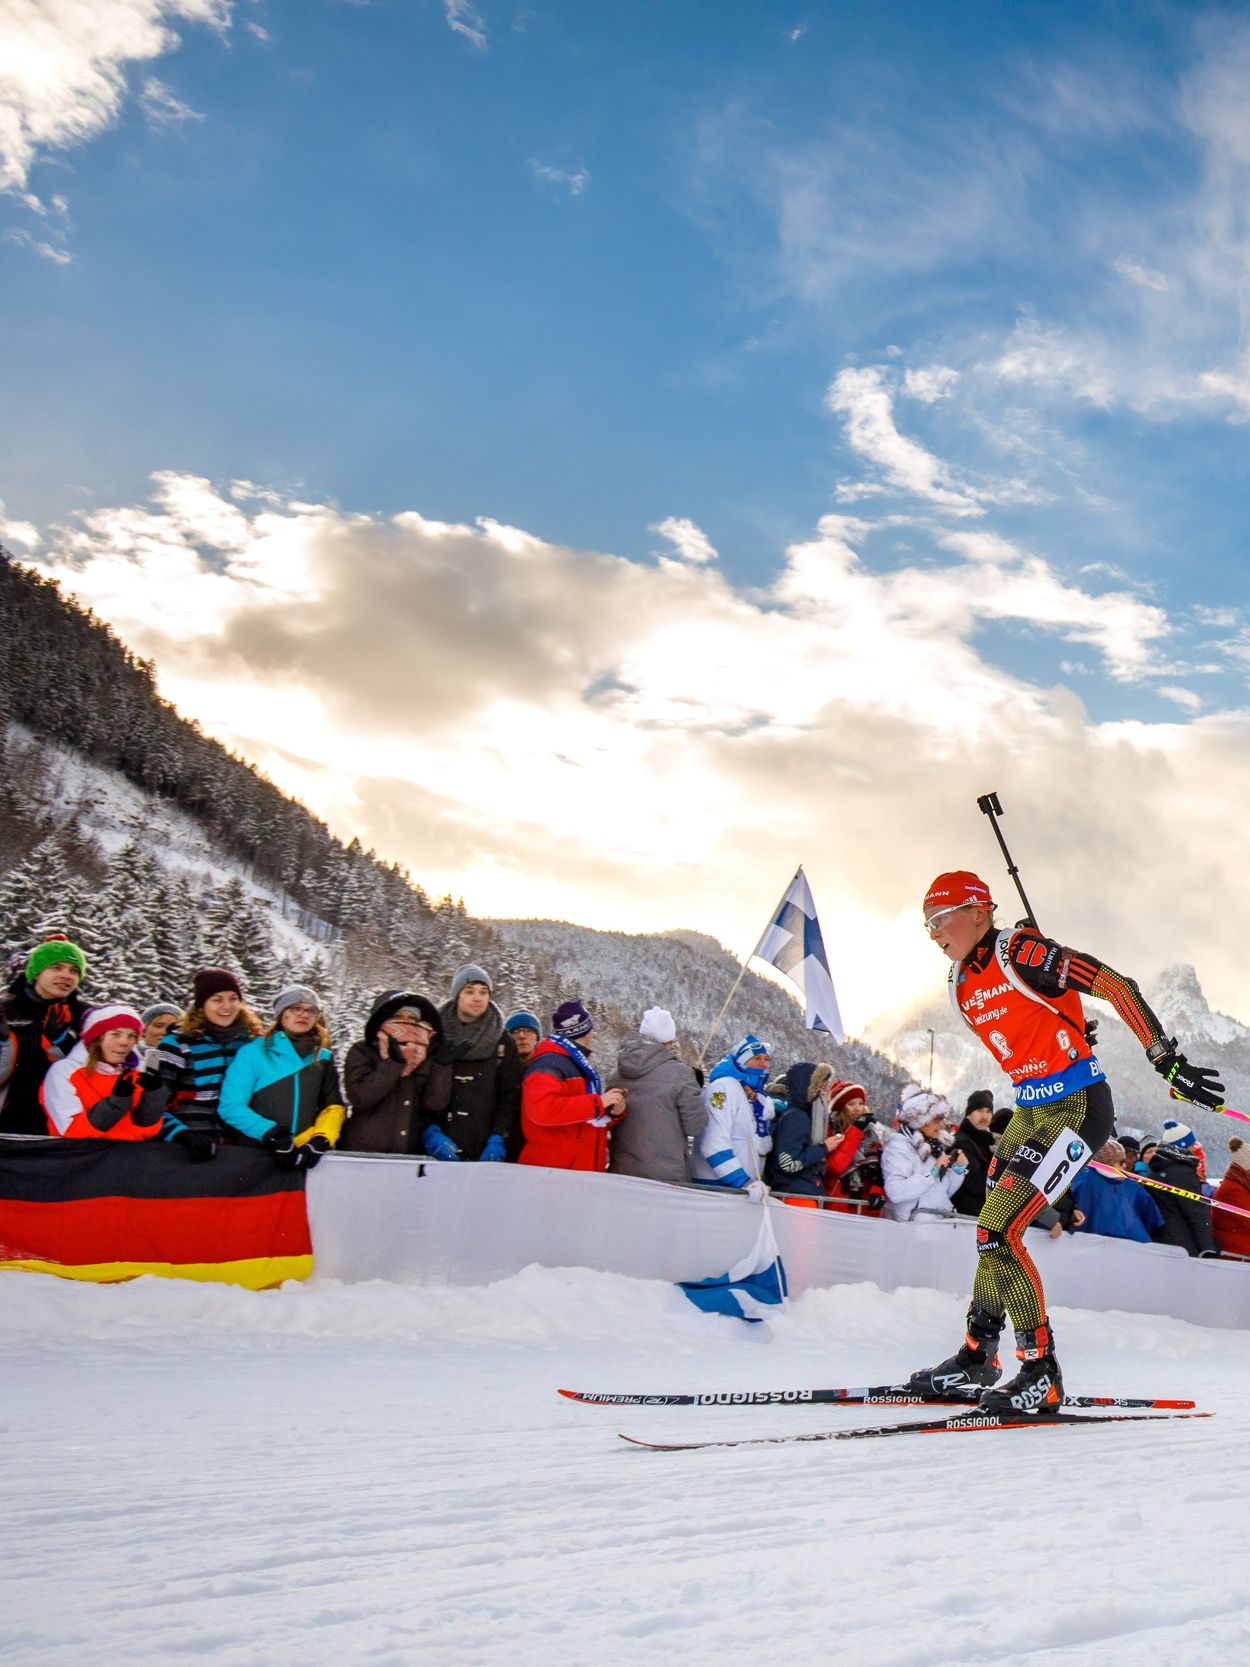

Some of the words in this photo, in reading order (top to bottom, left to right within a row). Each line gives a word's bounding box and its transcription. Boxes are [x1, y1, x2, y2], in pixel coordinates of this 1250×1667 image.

[1056, 1029, 1071, 1051] 6
[1021, 1081, 1064, 1101] xDrive
[1043, 1160, 1070, 1195] 6
[582, 1391, 641, 1405] PREMIUM
[863, 1395, 925, 1404] ROSSIGNOL
[1010, 1374, 1052, 1410] ROSSI
[946, 1415, 1002, 1429] ROSSIGNOL
